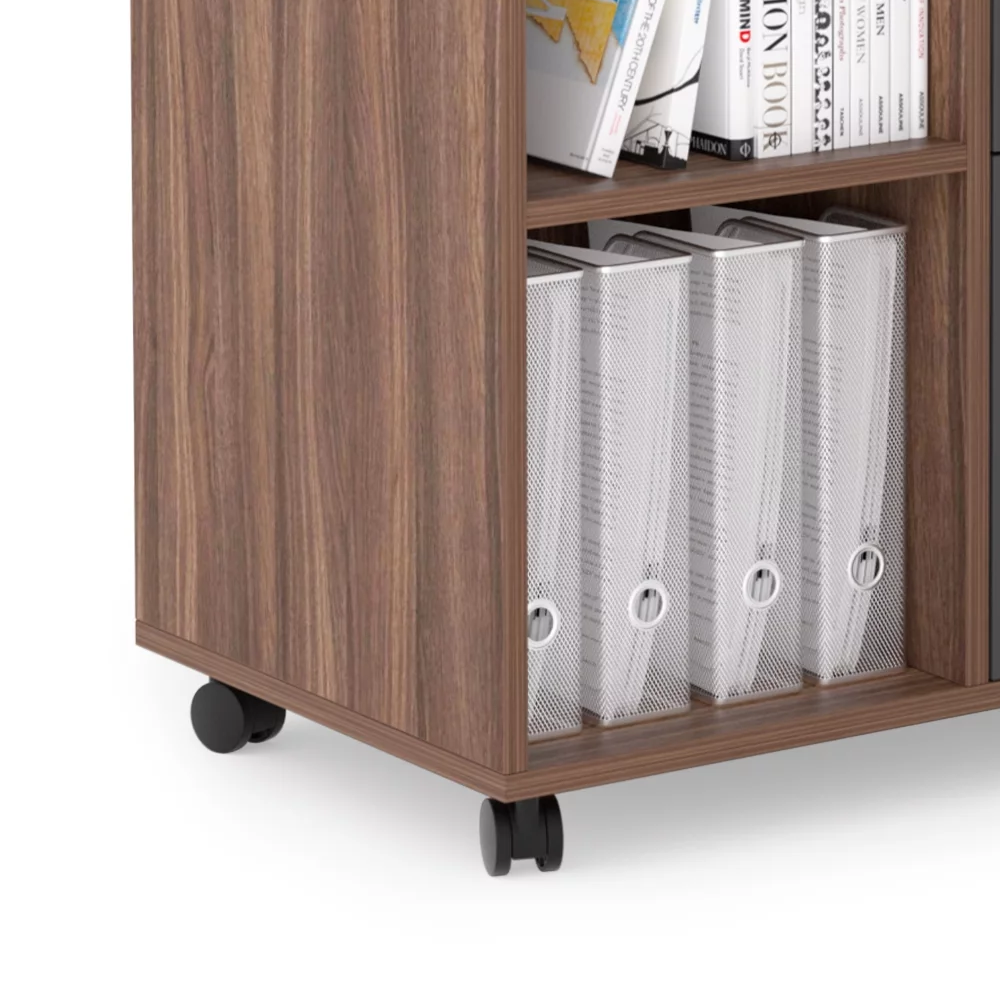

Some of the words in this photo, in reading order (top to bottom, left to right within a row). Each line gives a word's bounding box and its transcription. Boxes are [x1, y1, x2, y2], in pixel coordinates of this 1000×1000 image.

[641, 12, 652, 31] THE
[837, 6, 847, 61] Photographs
[856, 5, 865, 64] WOMEN
[876, 3, 885, 36] MEN
[632, 32, 646, 60] 20TH
[618, 61, 637, 111] CENTURY
[762, 62, 788, 152] BOOK
